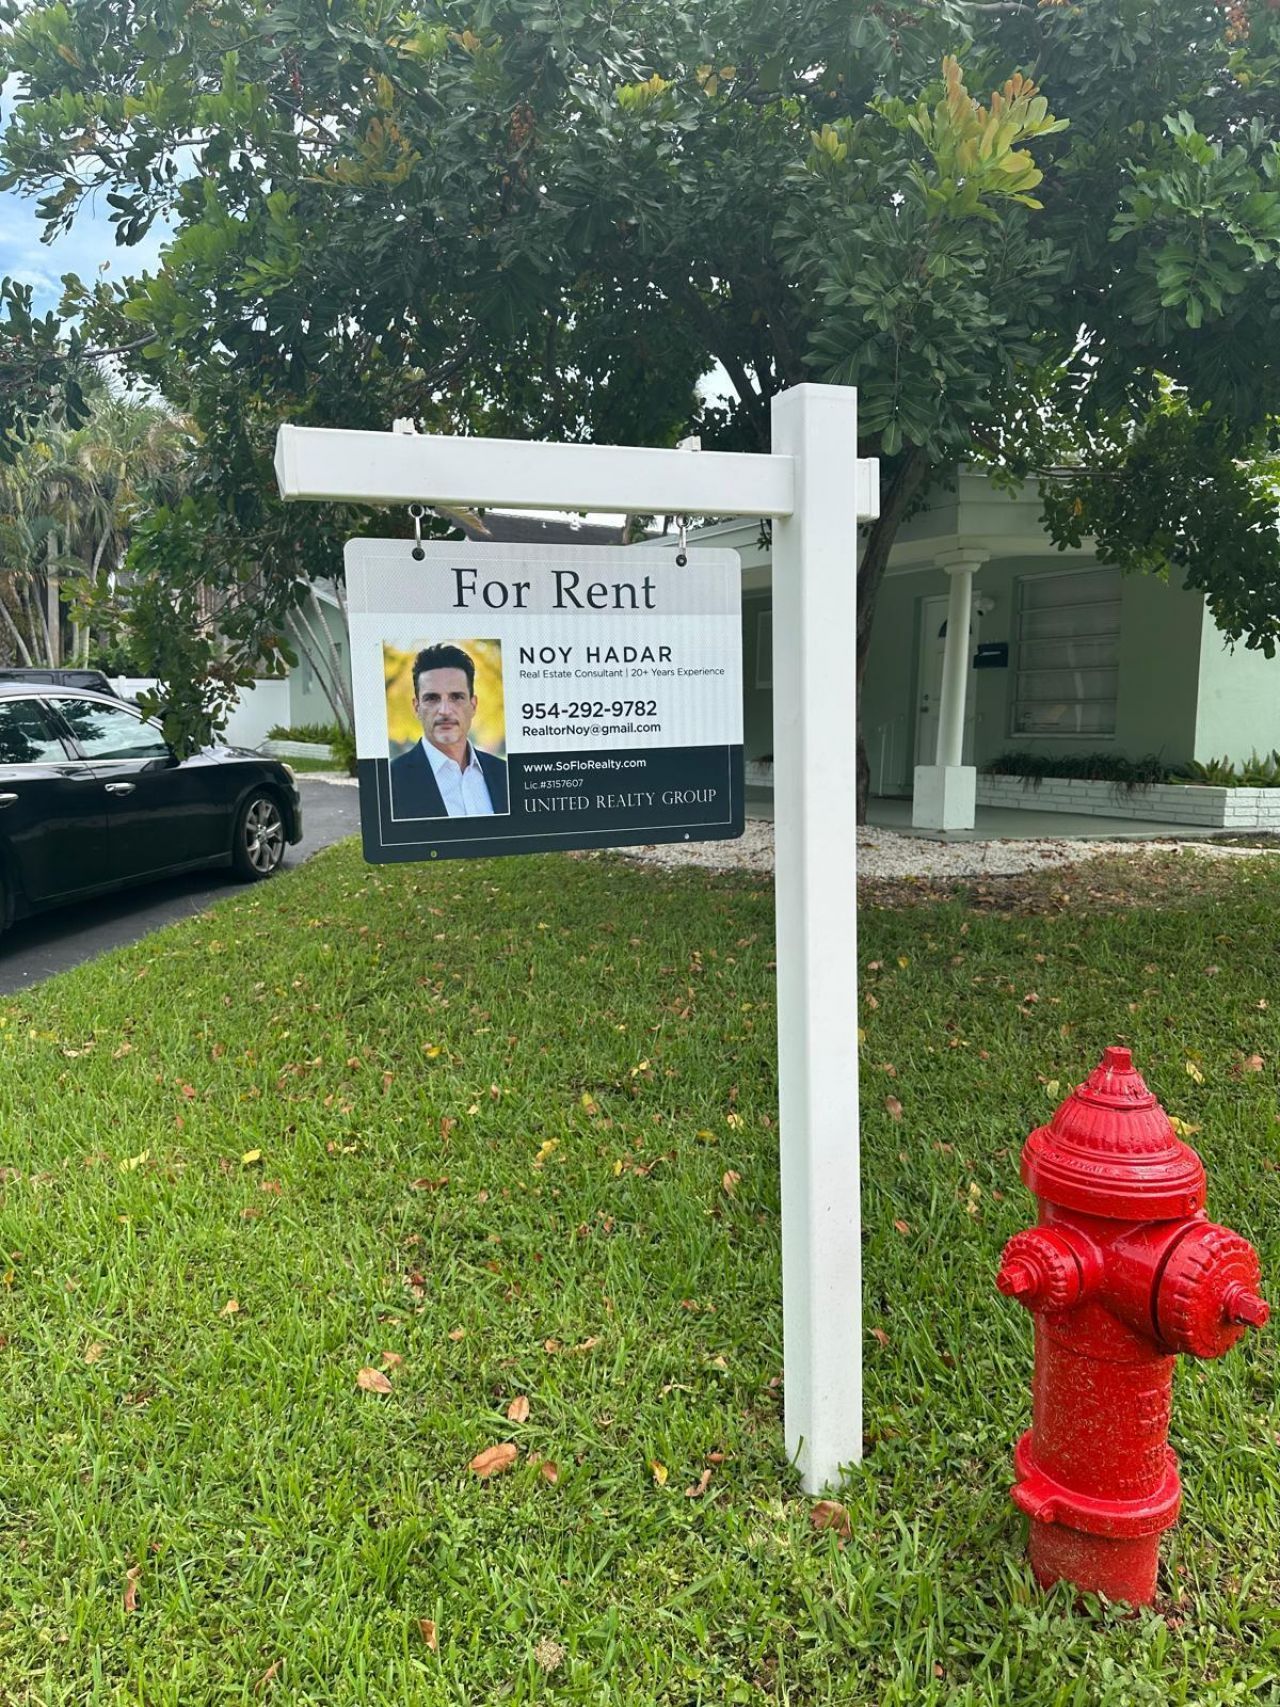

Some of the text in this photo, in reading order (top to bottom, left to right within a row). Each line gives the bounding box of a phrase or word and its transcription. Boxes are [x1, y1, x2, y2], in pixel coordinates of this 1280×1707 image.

[451, 567, 656, 609] For Rent
[520, 645, 672, 664] NOY HADAR
[520, 667, 725, 678] Real Estate Consultant 20+ Years Experience
[522, 700, 657, 719] 954-292-9782
[522, 722, 661, 737] RealtorNoy@gmail.com
[523, 758, 647, 773] www.SoFloRealty.com
[524, 779, 584, 790] Lic.#3157607
[525, 789, 717, 812] UNITED REALTY GROUP
